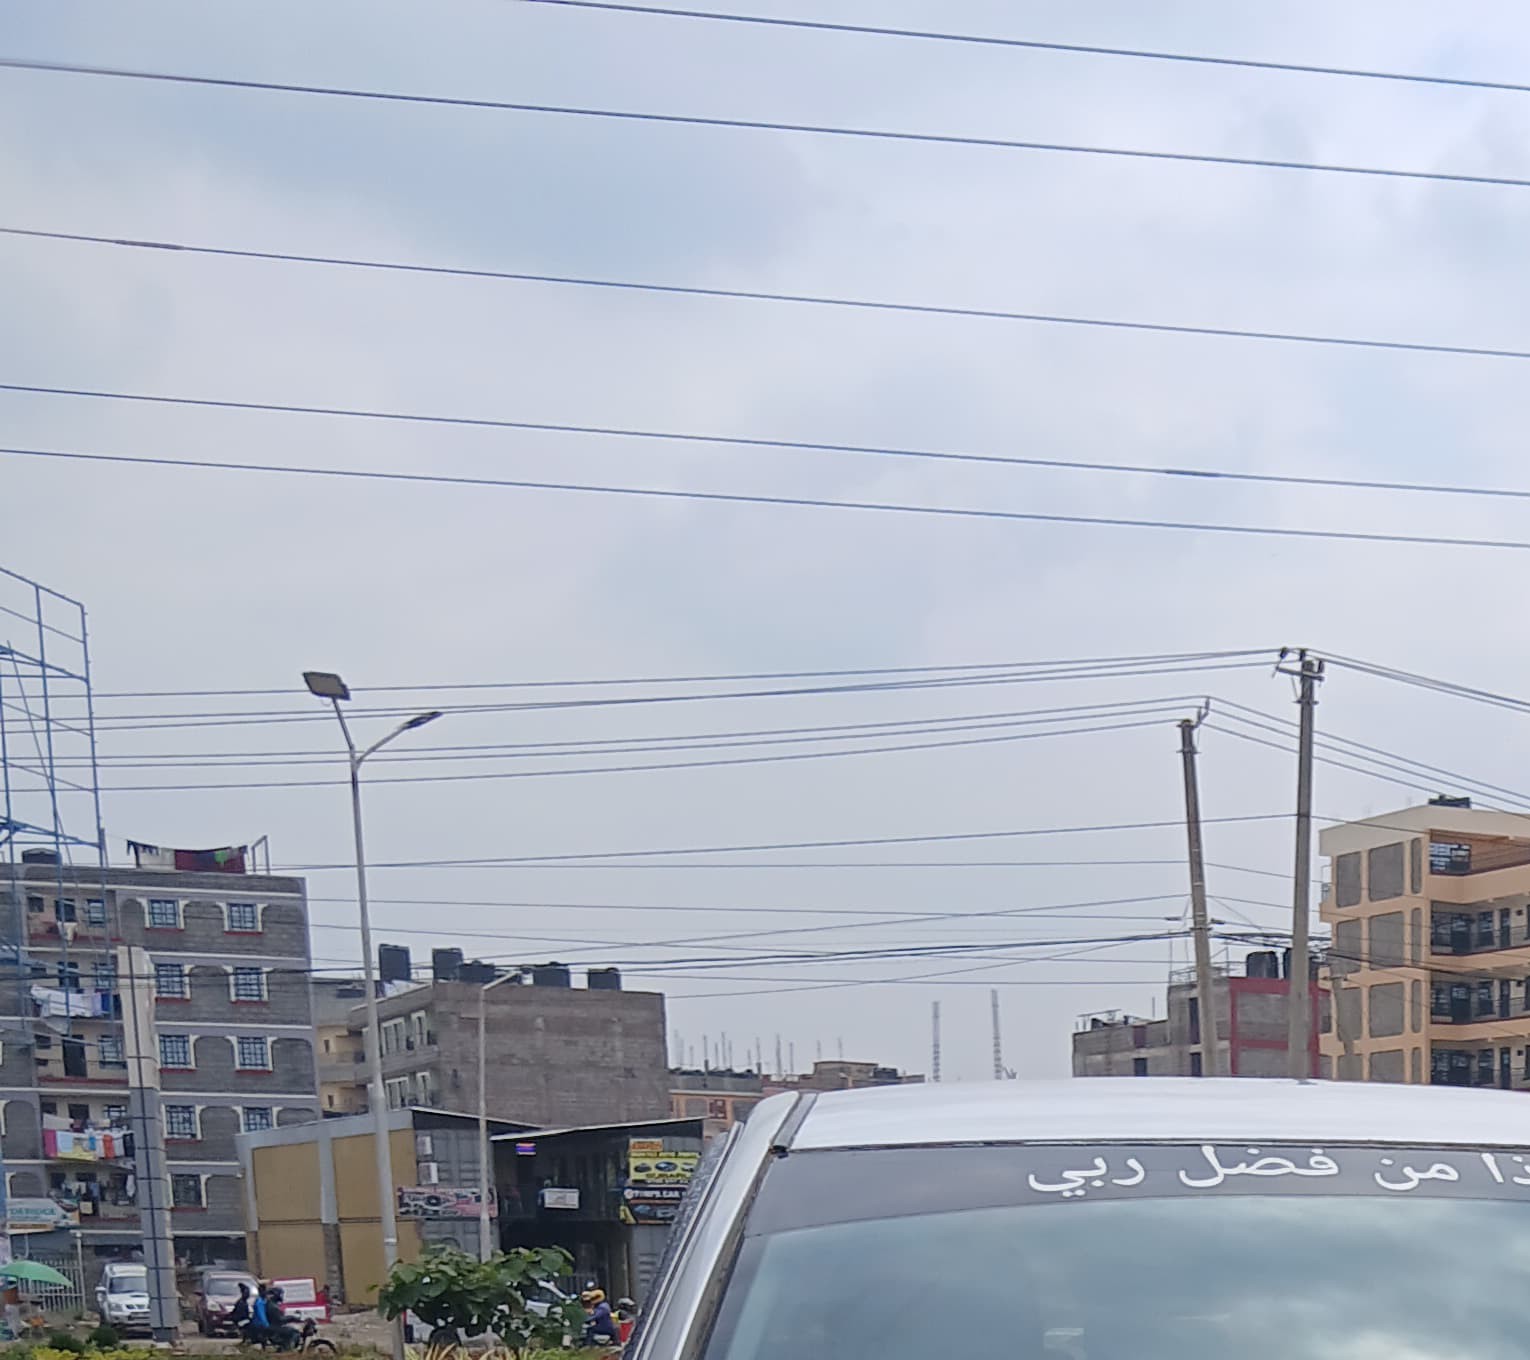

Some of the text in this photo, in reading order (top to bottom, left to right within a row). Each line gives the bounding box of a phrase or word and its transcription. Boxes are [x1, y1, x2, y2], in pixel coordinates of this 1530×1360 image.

[1027, 1157, 1147, 1198] ربي
[1178, 1146, 1340, 1189] فضل
[1373, 1158, 1460, 1192] من
